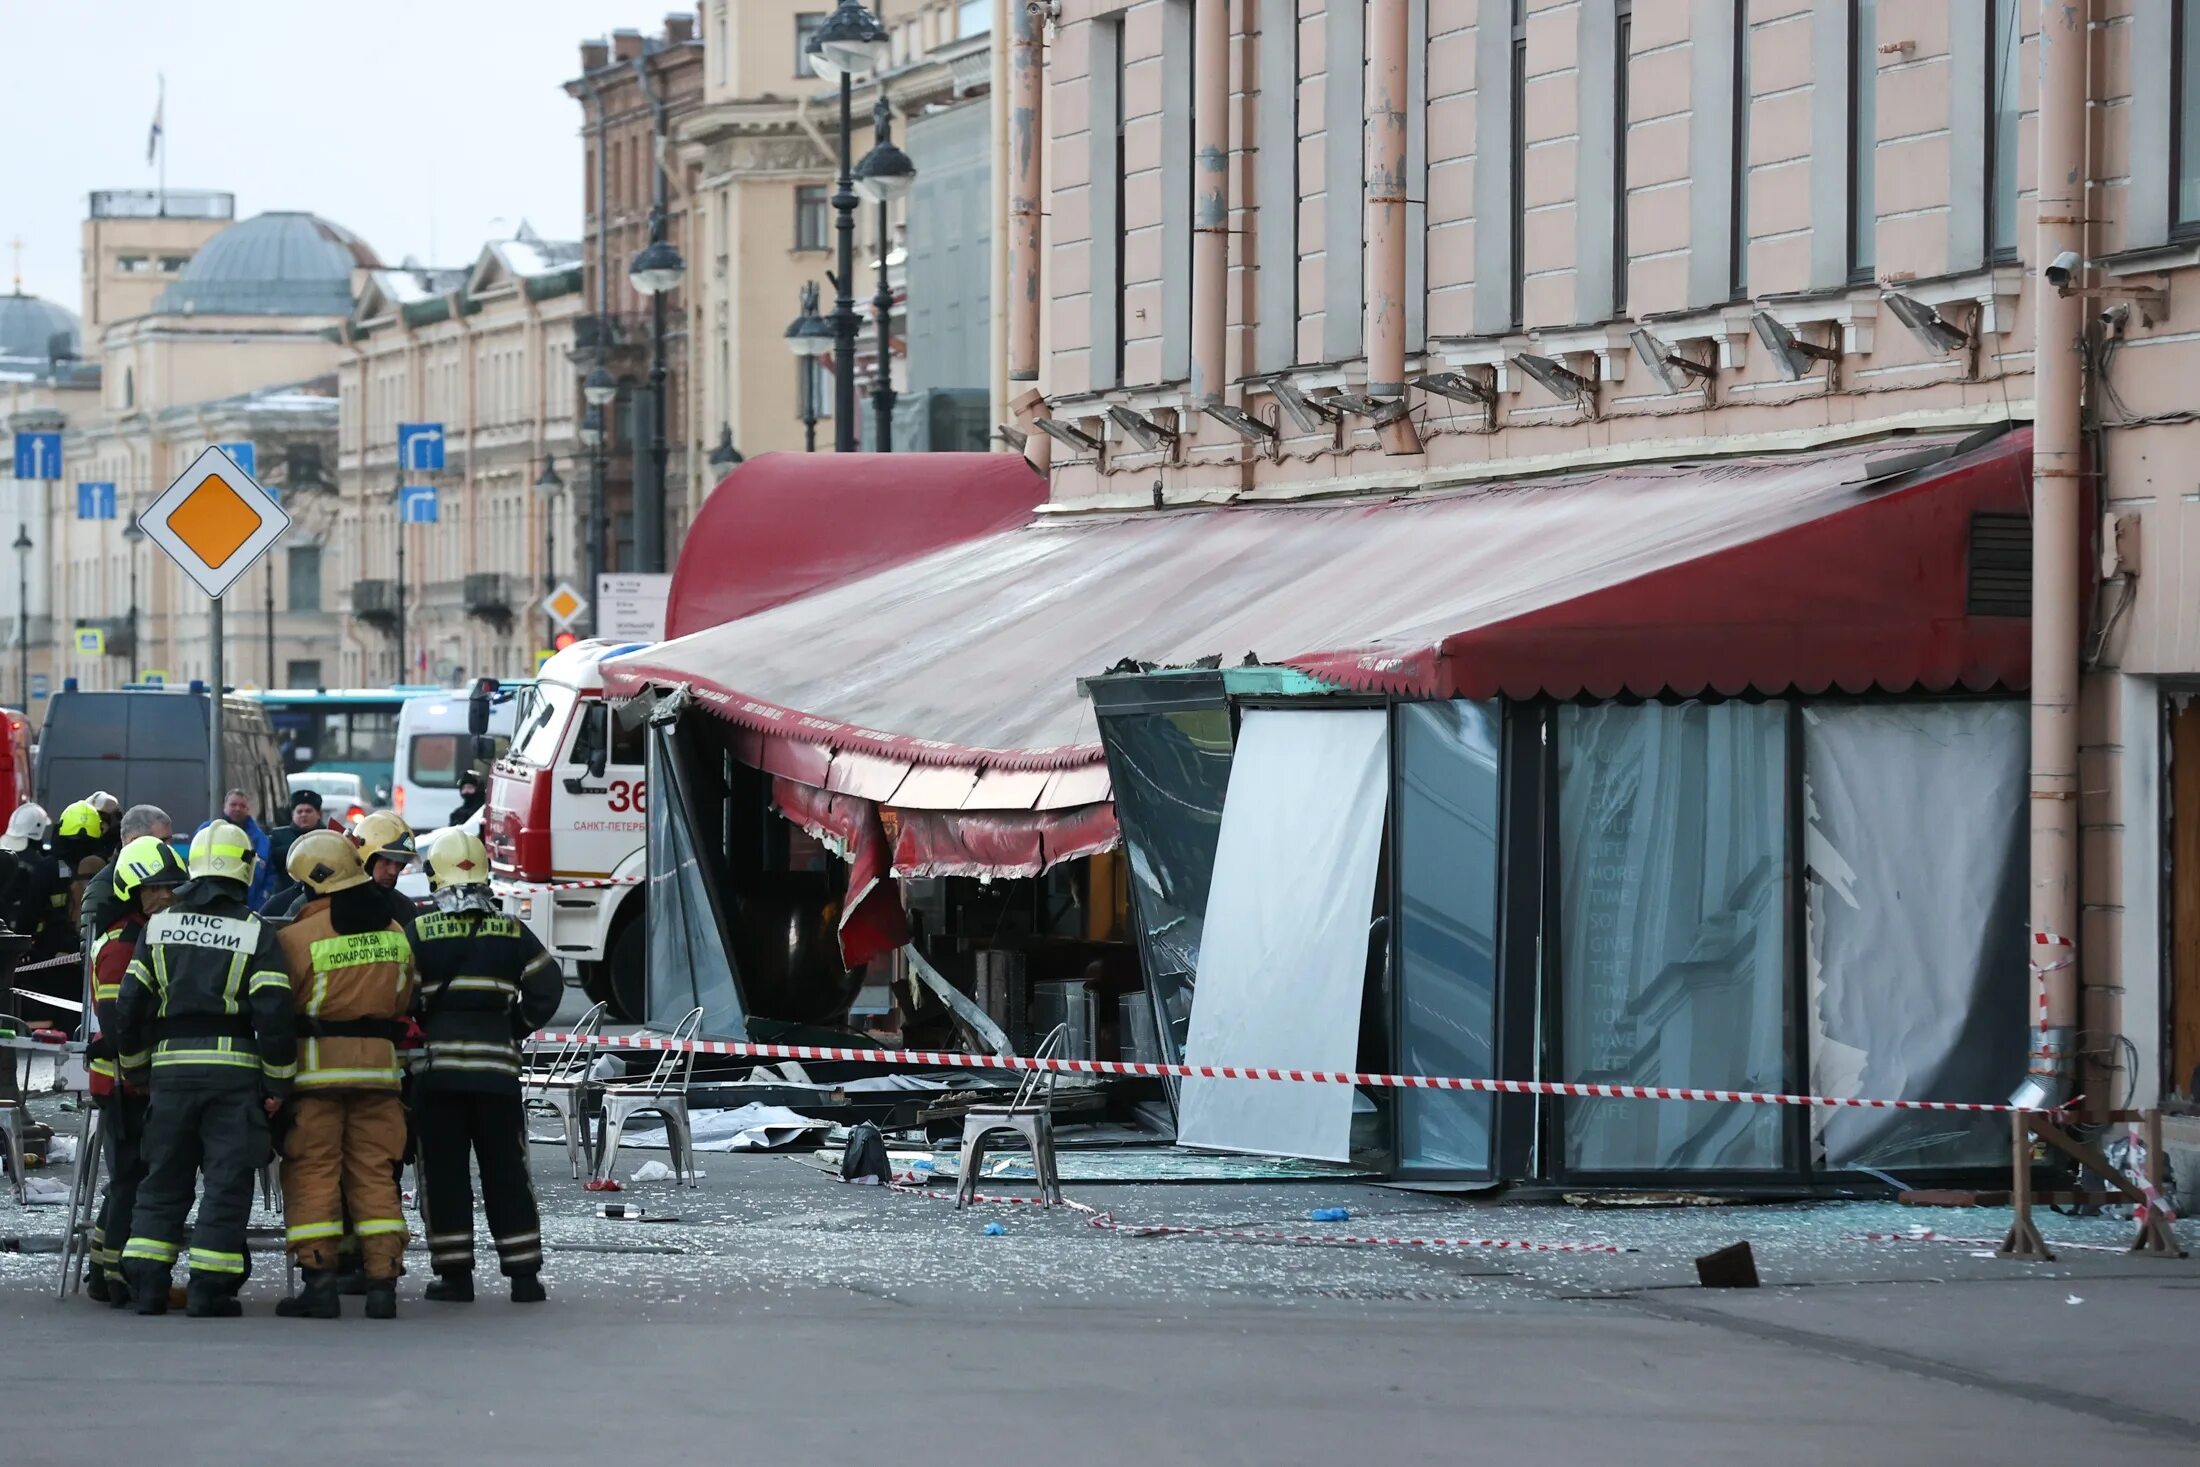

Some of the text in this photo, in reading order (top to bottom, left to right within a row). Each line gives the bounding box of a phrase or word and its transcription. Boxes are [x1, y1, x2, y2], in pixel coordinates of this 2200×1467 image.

[1589, 841, 1625, 857] LIFE
[1588, 865, 1639, 881] MORE
[1589, 889, 1633, 905] TIME
[180, 914, 224, 929] МЧС
[1589, 912, 1612, 929] SO
[160, 929, 241, 949] РОССИИ
[347, 934, 380, 948] СЛУЖБА
[1590, 936, 1633, 953] GIVE
[329, 947, 399, 965] ПОЖАРОТУШЕНИЯ
[1589, 960, 1626, 976] THE
[1591, 984, 1632, 1000] TIME
[1591, 1008, 1628, 1024] YOU
[1591, 1031, 1637, 1048] HAVE
[1591, 1055, 1632, 1071] LEFT
